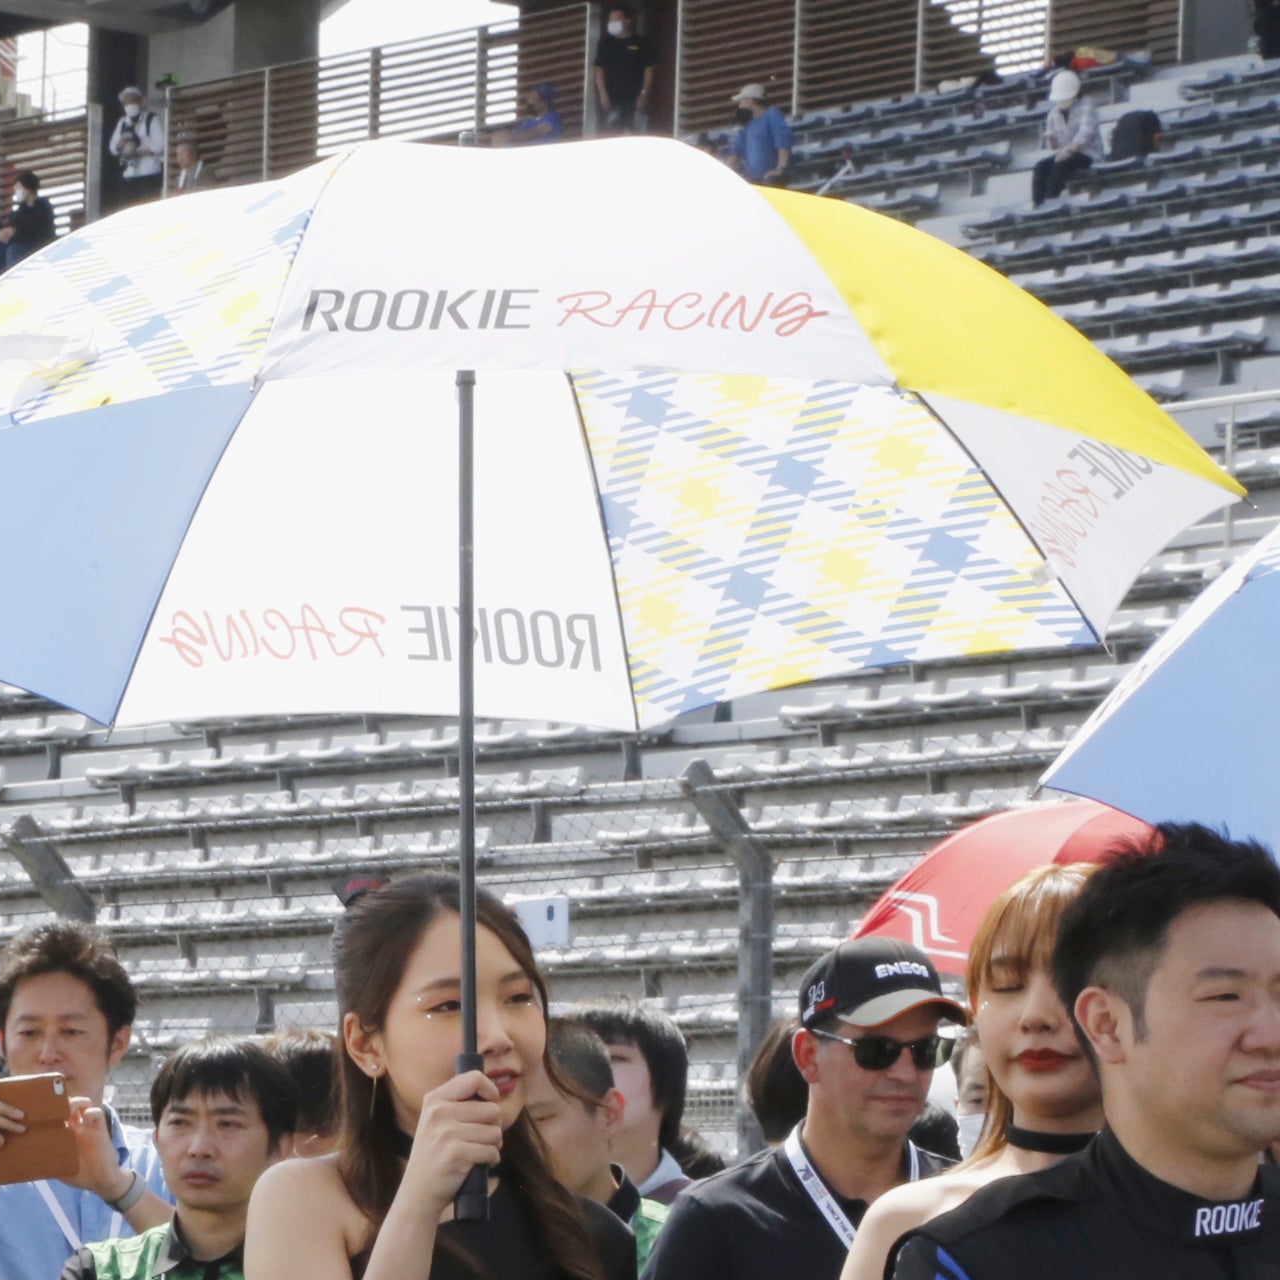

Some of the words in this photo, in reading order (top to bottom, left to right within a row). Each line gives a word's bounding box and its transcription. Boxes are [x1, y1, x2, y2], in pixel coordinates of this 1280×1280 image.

[301, 288, 540, 332] ROOKIE
[556, 288, 829, 337] RACING
[875, 962, 930, 979] ENEOS
[1195, 1199, 1264, 1237] ROOKIE
